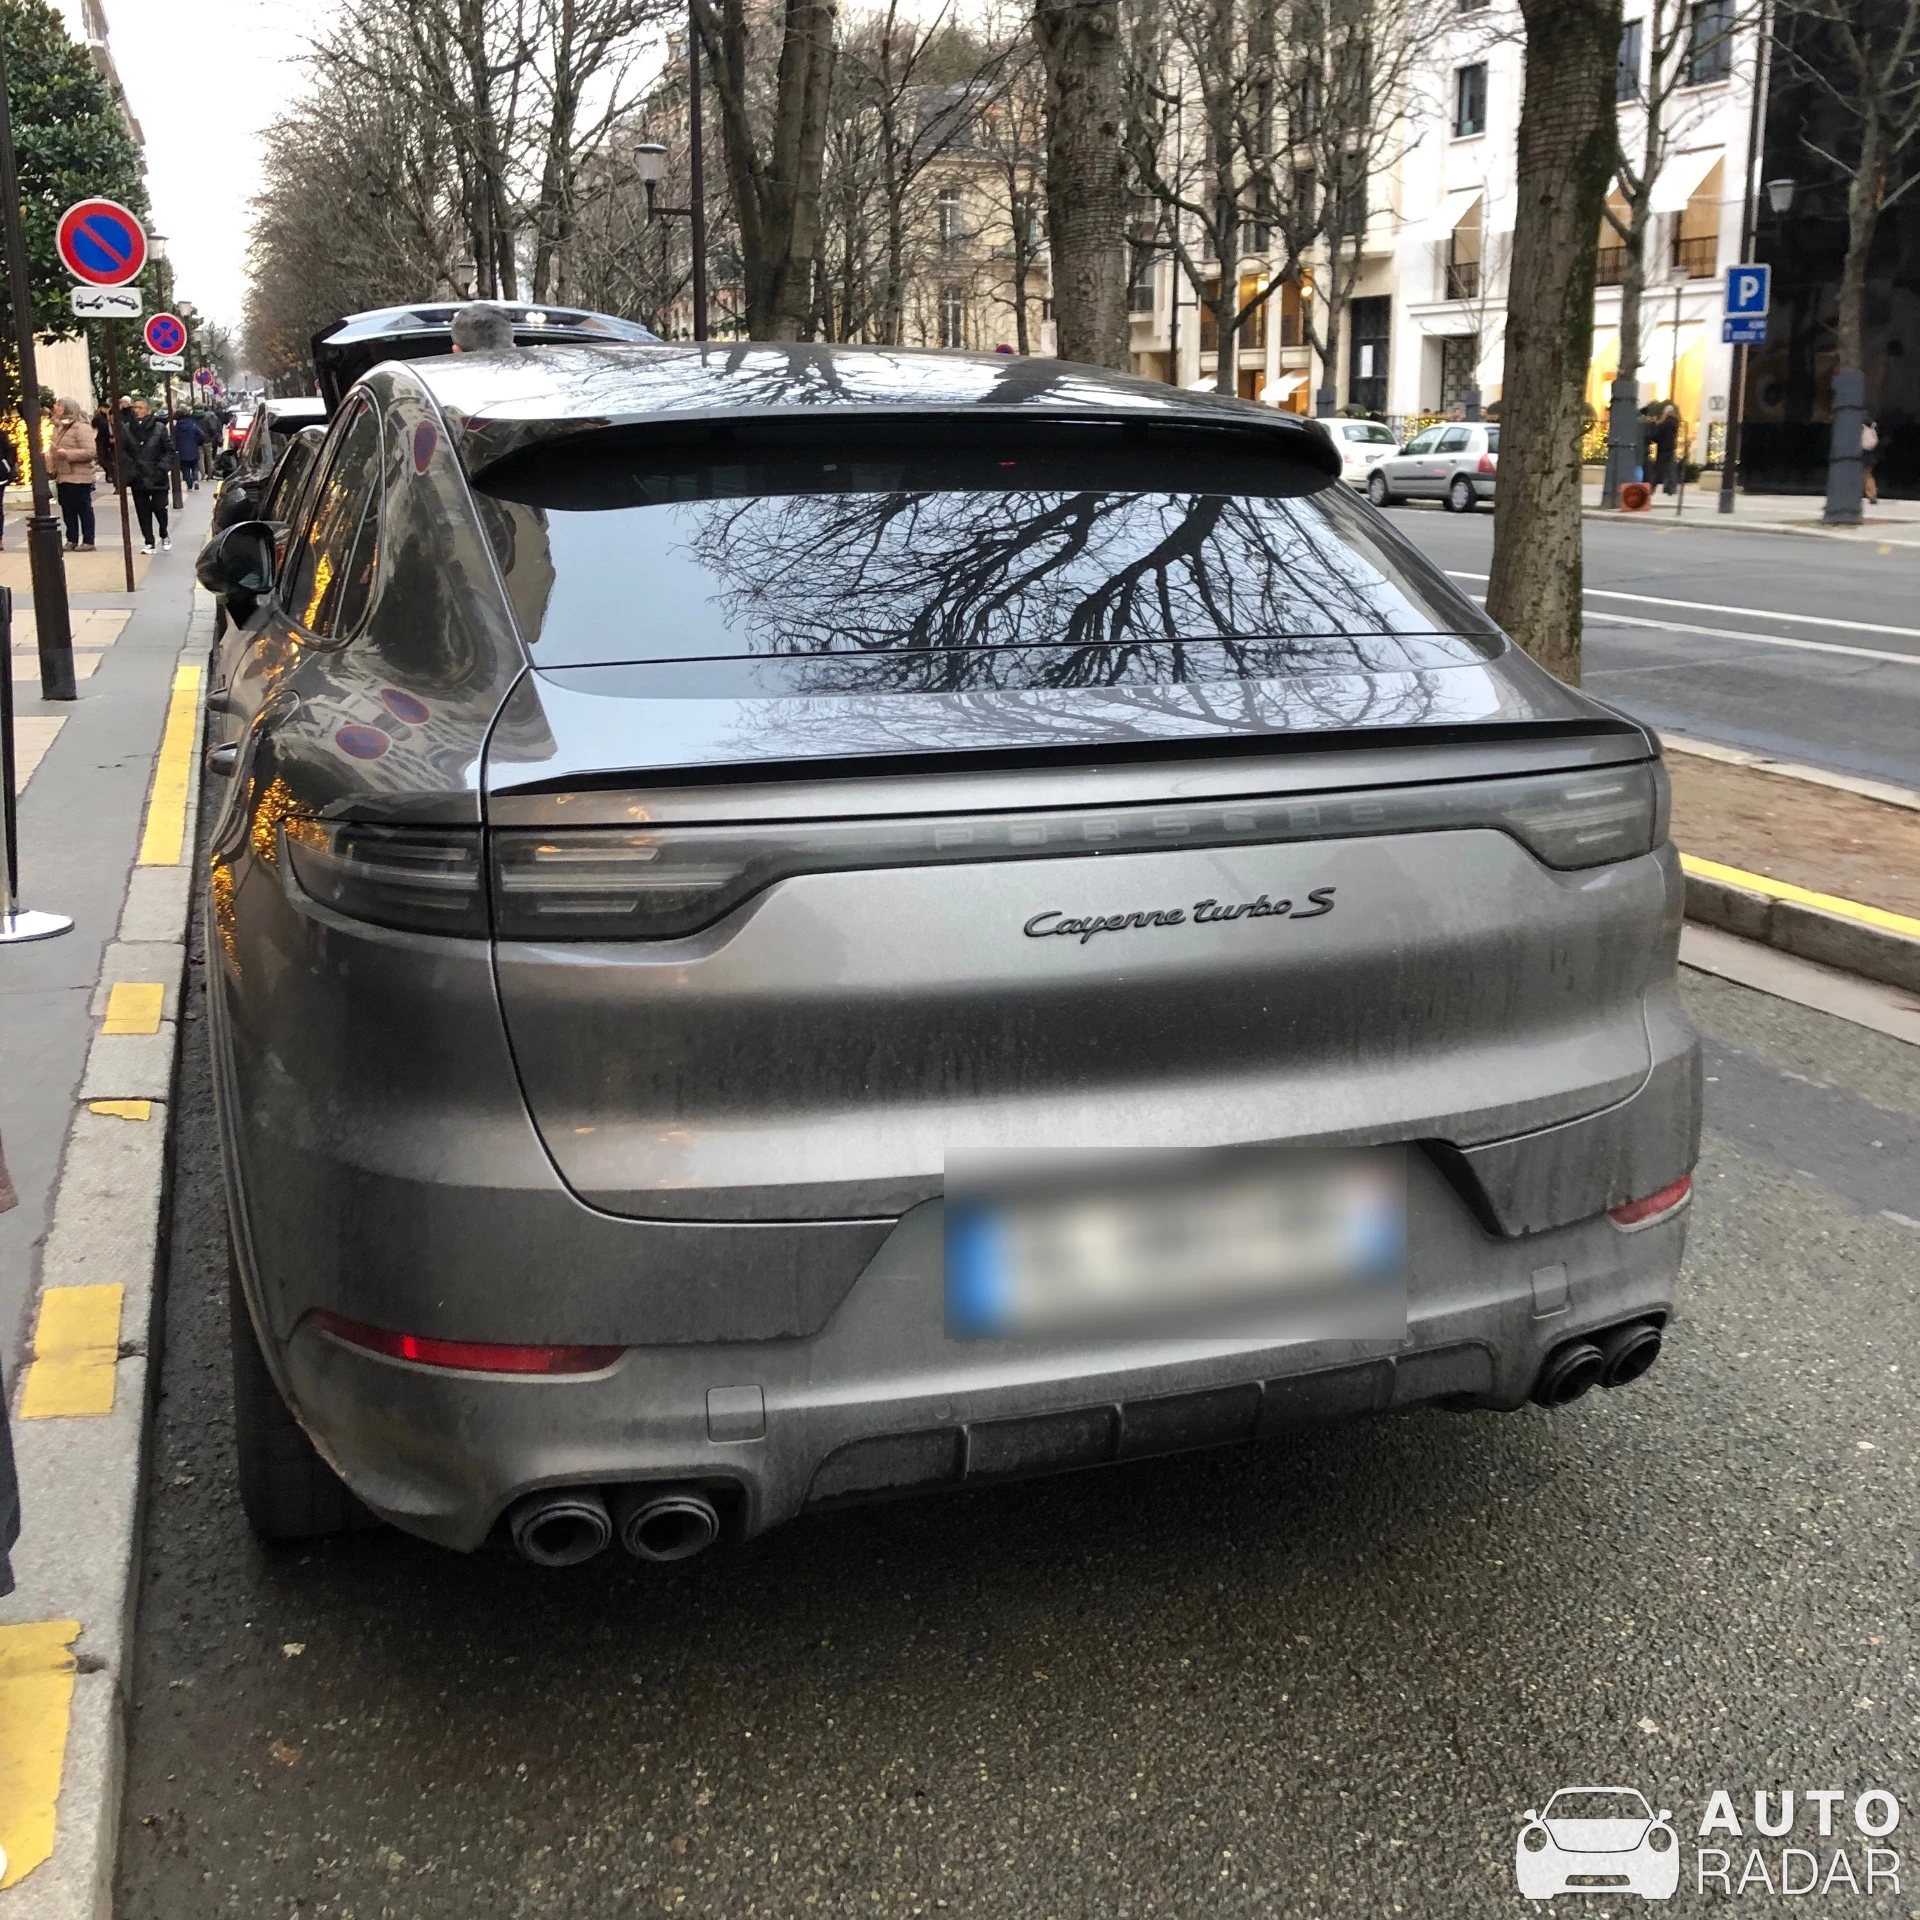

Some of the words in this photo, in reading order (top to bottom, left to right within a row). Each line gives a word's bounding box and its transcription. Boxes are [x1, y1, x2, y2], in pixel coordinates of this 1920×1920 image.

[1739, 275, 1760, 307] P
[1024, 908, 1186, 944] Cayenne
[1193, 895, 1293, 922] turbo
[1289, 887, 1337, 919] S
